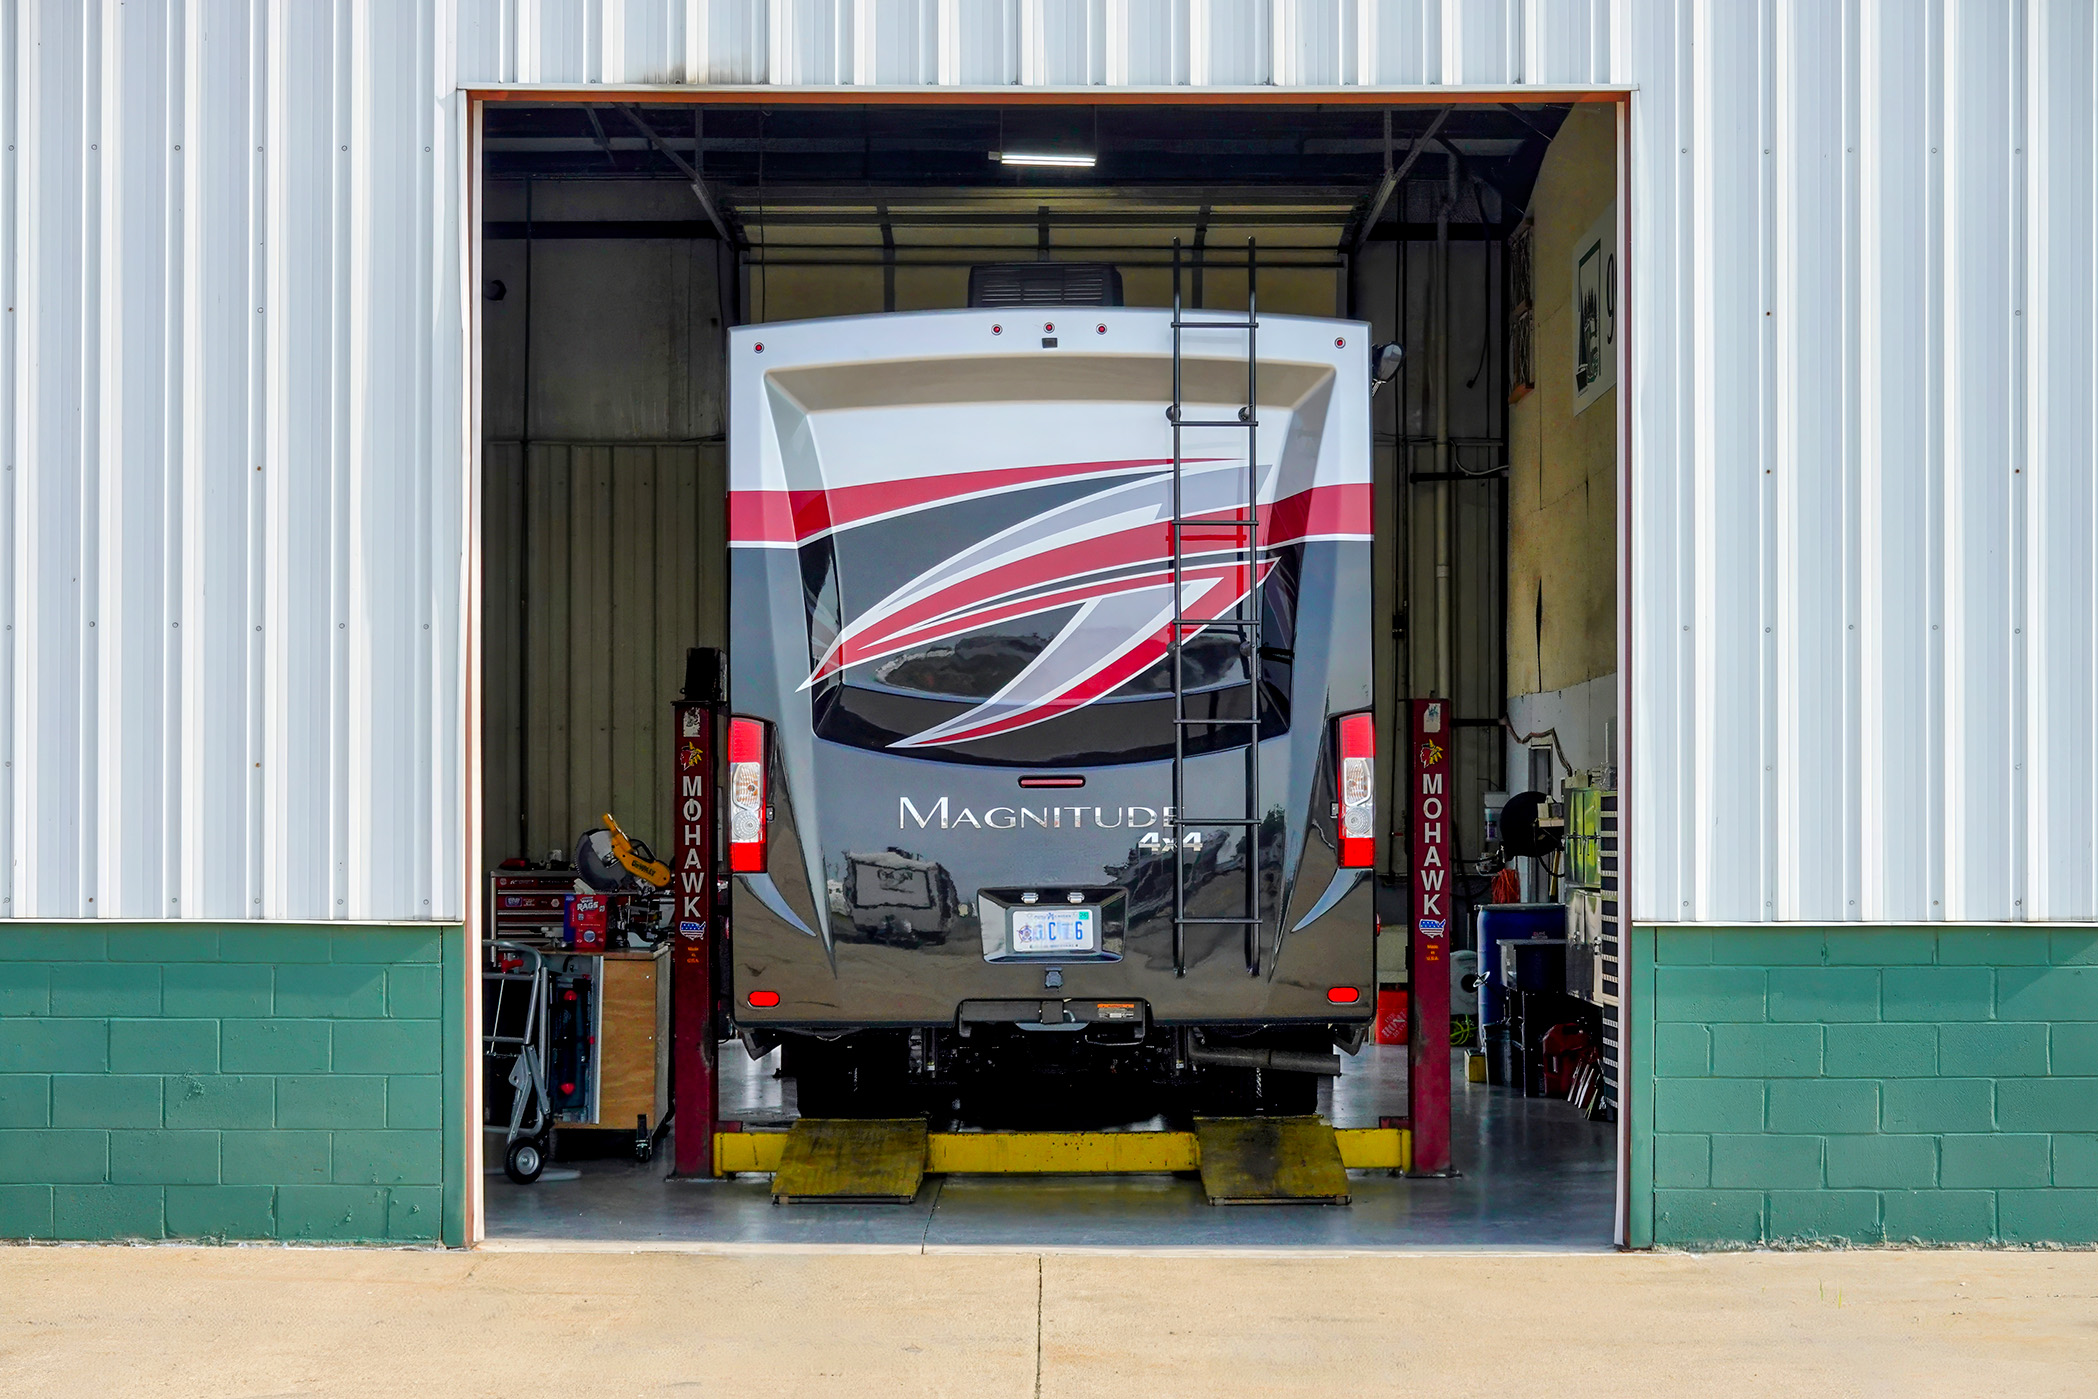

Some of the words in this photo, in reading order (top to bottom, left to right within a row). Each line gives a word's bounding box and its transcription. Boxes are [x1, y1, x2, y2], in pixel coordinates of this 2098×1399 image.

[577, 901, 599, 912] RAGS
[681, 775, 704, 917] MOHAWK
[1420, 773, 1444, 915] MOHAWK
